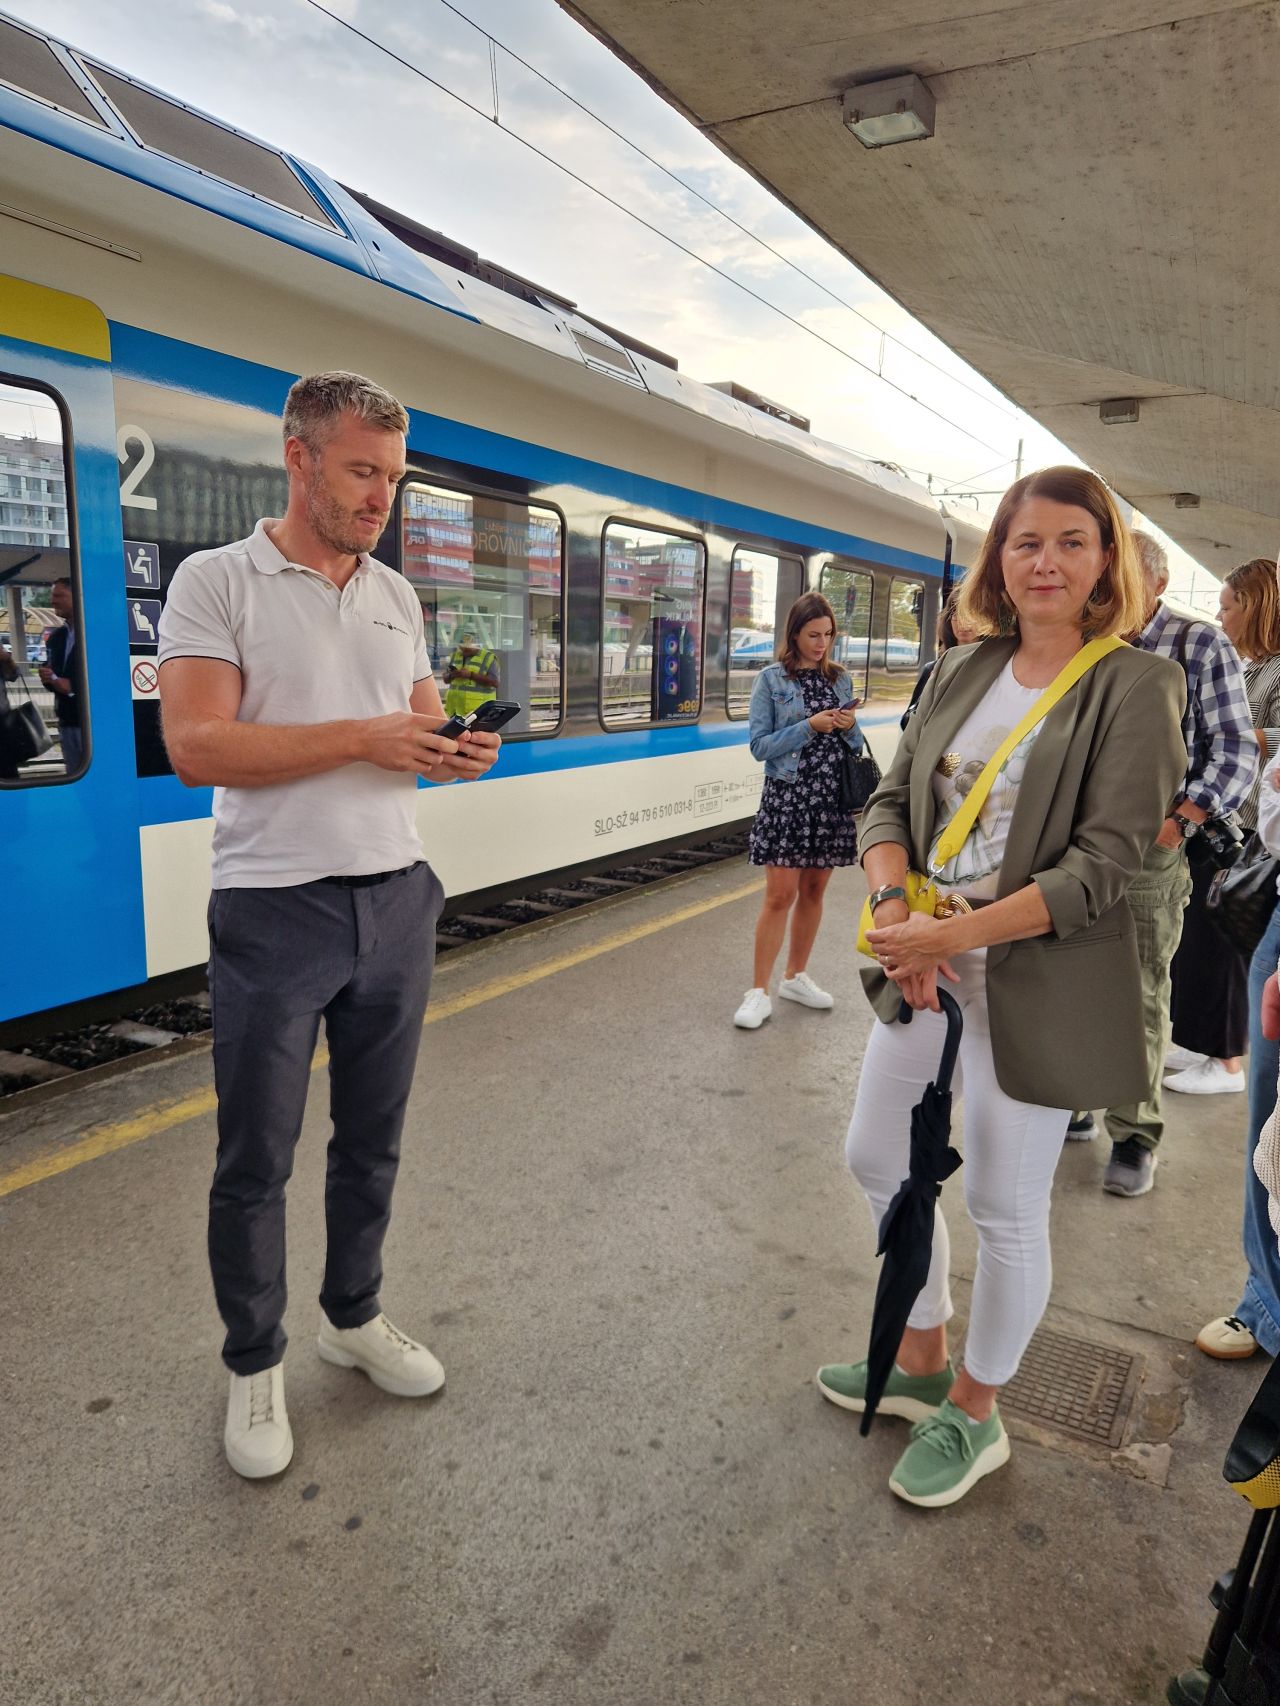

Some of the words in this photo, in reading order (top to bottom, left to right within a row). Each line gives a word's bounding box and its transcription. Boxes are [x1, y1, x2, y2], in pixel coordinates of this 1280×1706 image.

[117, 424, 158, 510] 2
[594, 811, 628, 834] SLO-SŽ
[629, 811, 639, 826] 94
[641, 808, 651, 822] 79
[652, 807, 658, 820] 6
[659, 803, 673, 818] 510
[674, 799, 693, 815] 031-8
